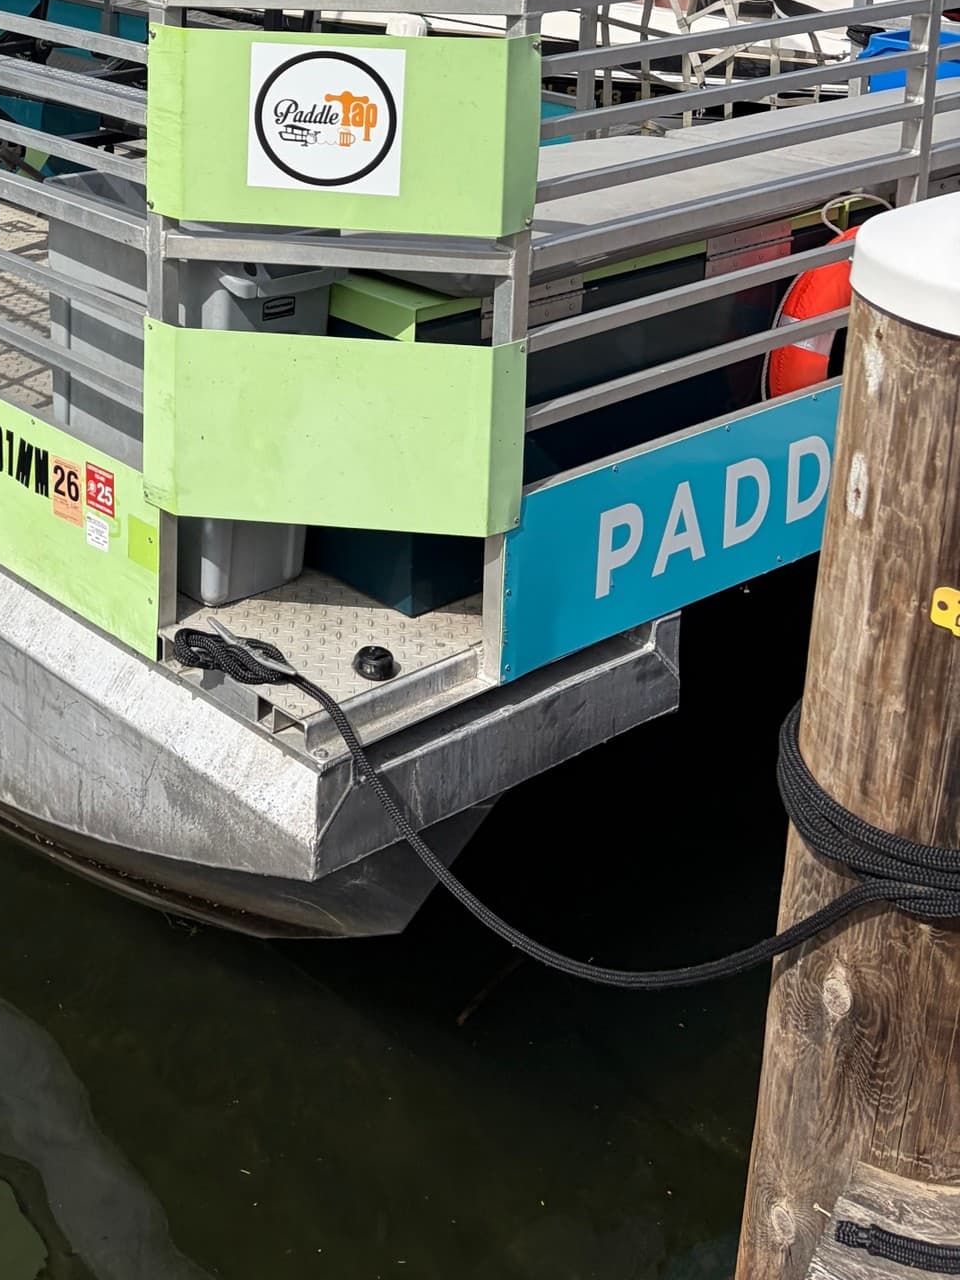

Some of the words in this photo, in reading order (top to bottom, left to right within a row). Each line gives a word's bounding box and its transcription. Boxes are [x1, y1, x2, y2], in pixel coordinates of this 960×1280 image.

[273, 98, 340, 125] Paddle
[325, 91, 378, 141] Tap
[53, 465, 80, 502] 26
[96, 482, 113, 507] 25
